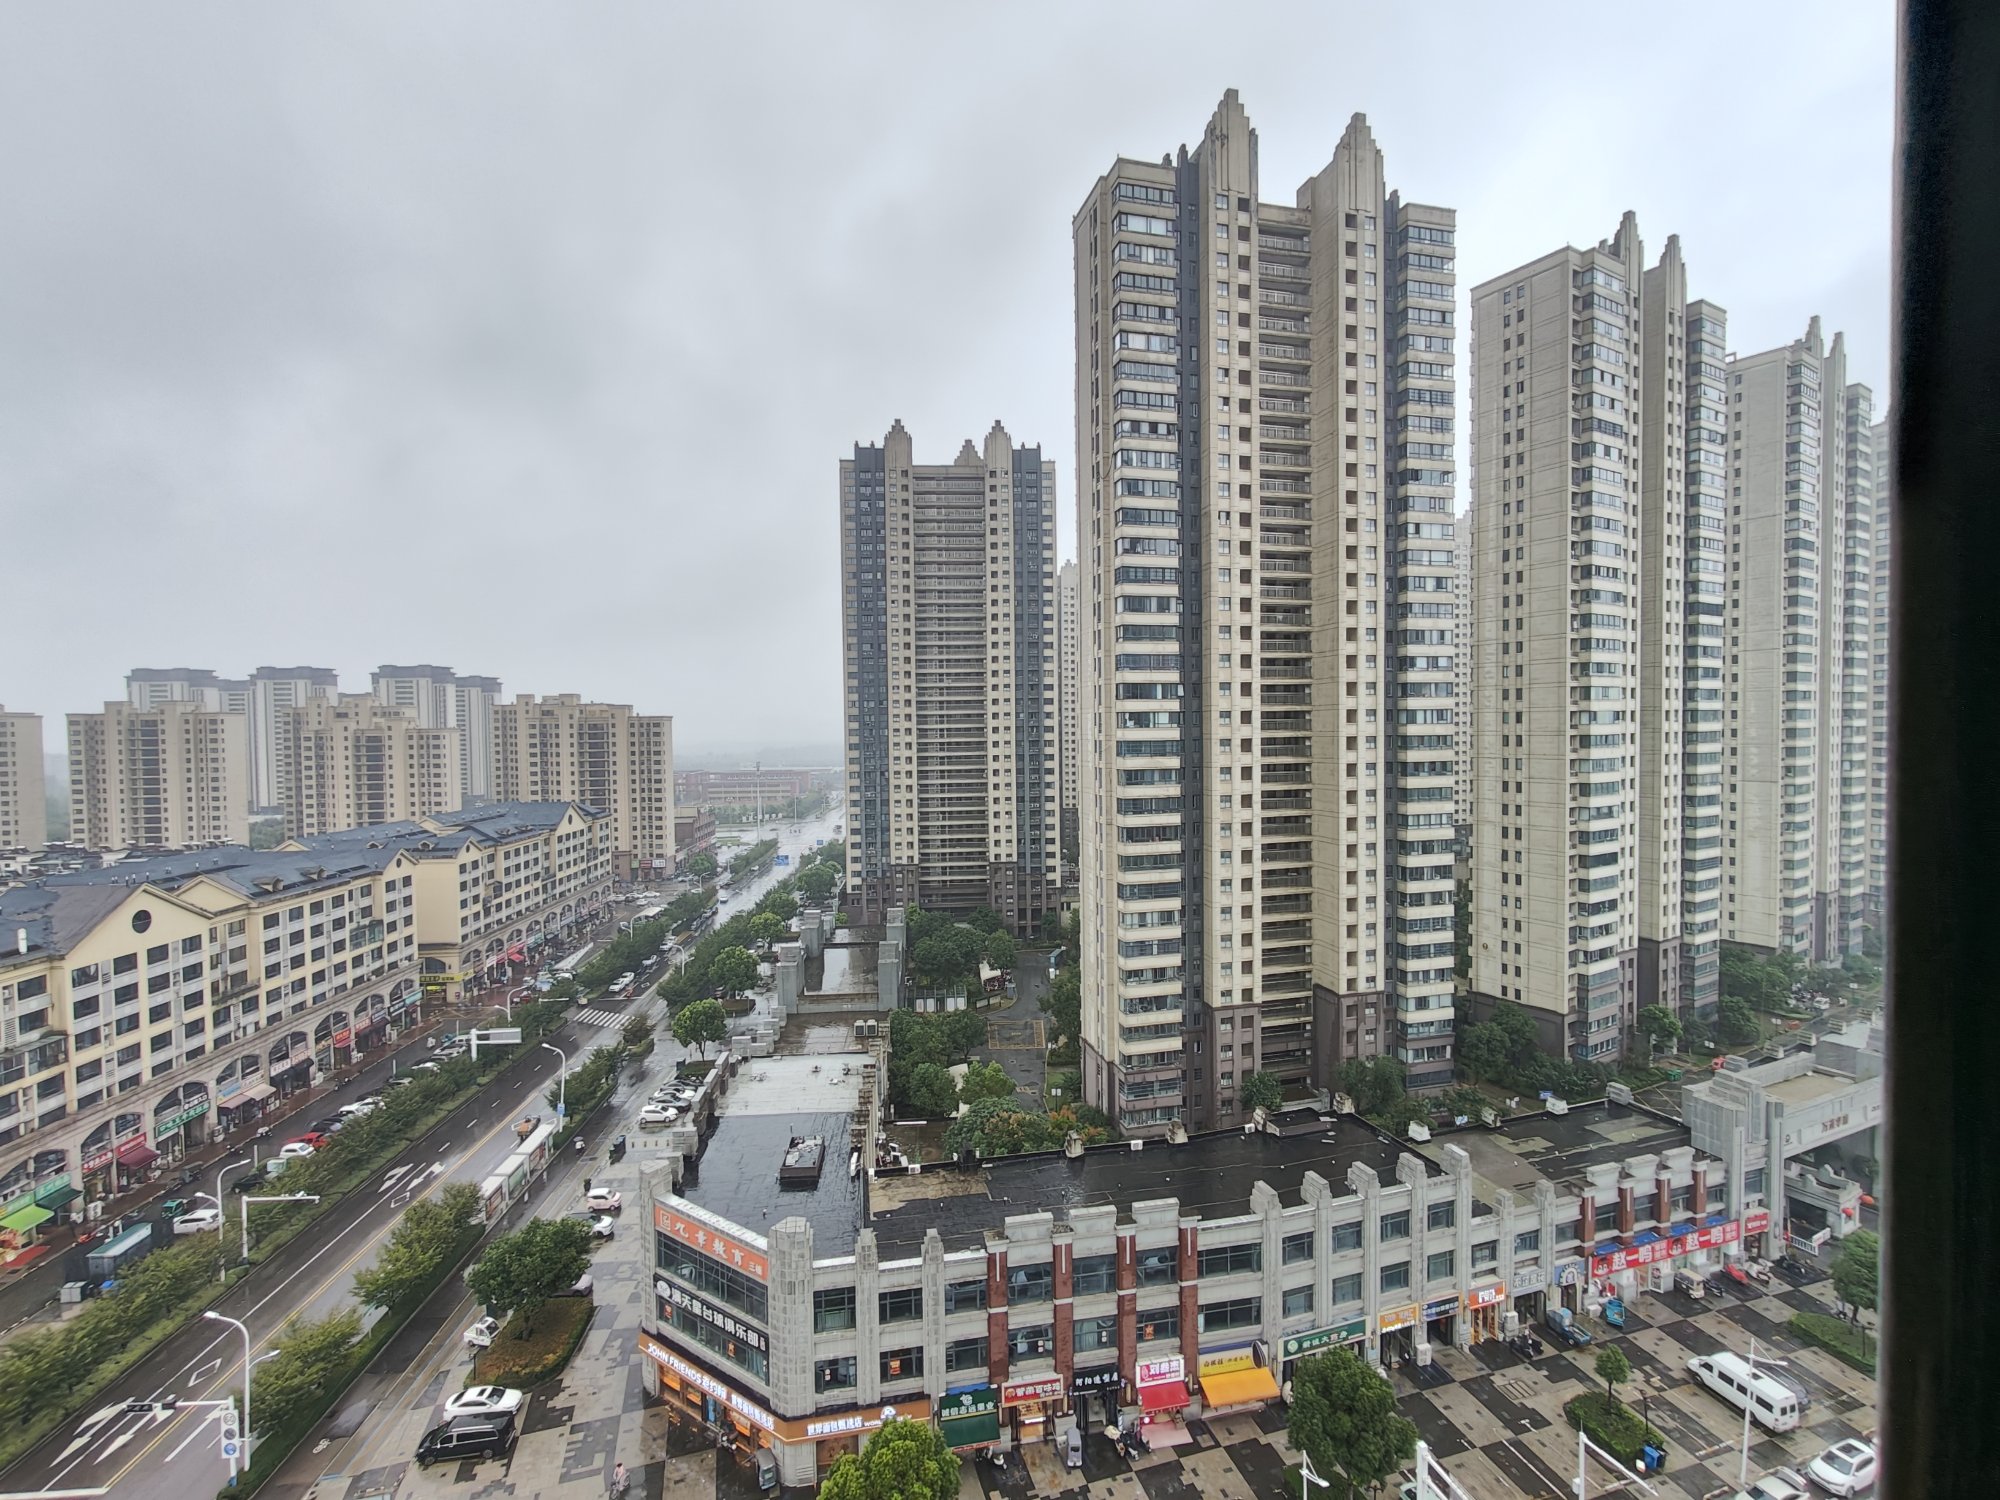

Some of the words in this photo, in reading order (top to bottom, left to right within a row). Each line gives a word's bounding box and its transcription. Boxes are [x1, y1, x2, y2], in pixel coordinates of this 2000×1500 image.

[674, 1222, 744, 1265] 九章教育
[1685, 1226, 1723, 1250] 赵一鸣
[1612, 1244, 1651, 1271] 赵一鸣
[648, 1343, 668, 1362] JOHN
[669, 1356, 701, 1383] FRIENDS
